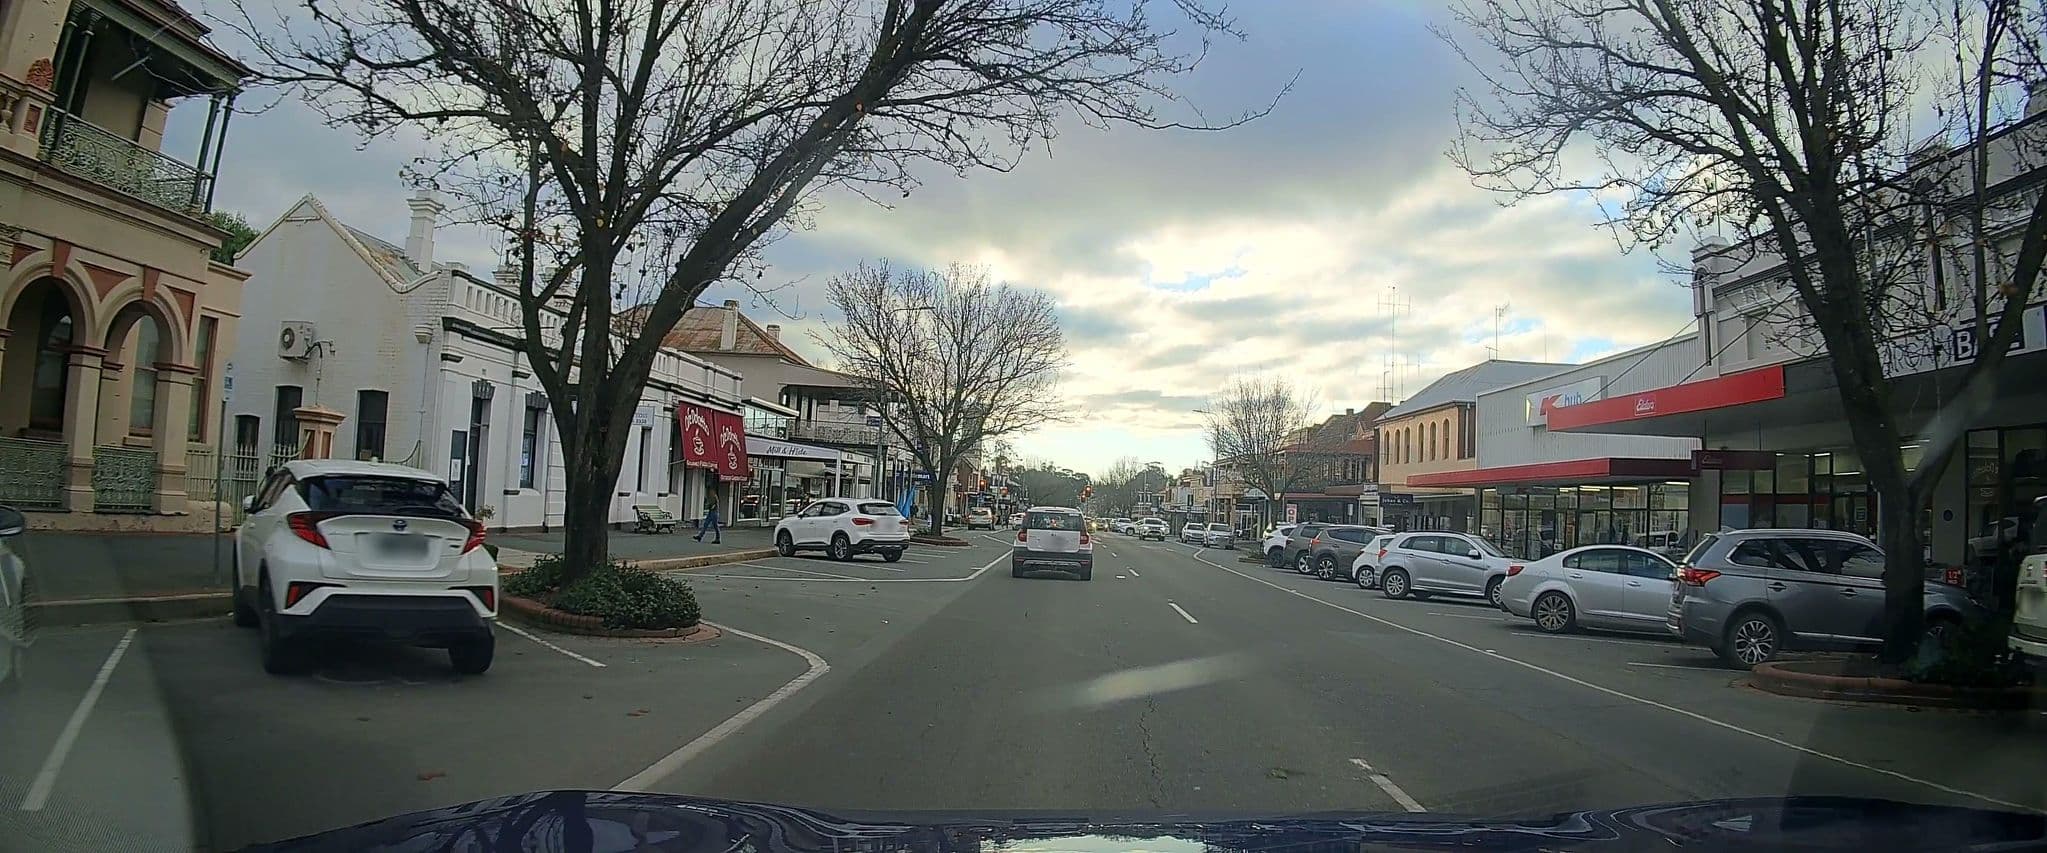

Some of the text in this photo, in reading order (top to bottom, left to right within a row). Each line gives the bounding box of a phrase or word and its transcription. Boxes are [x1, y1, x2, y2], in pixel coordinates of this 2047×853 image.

[1565, 391, 1582, 408] hub
[766, 445, 808, 455] Mill & Hide
